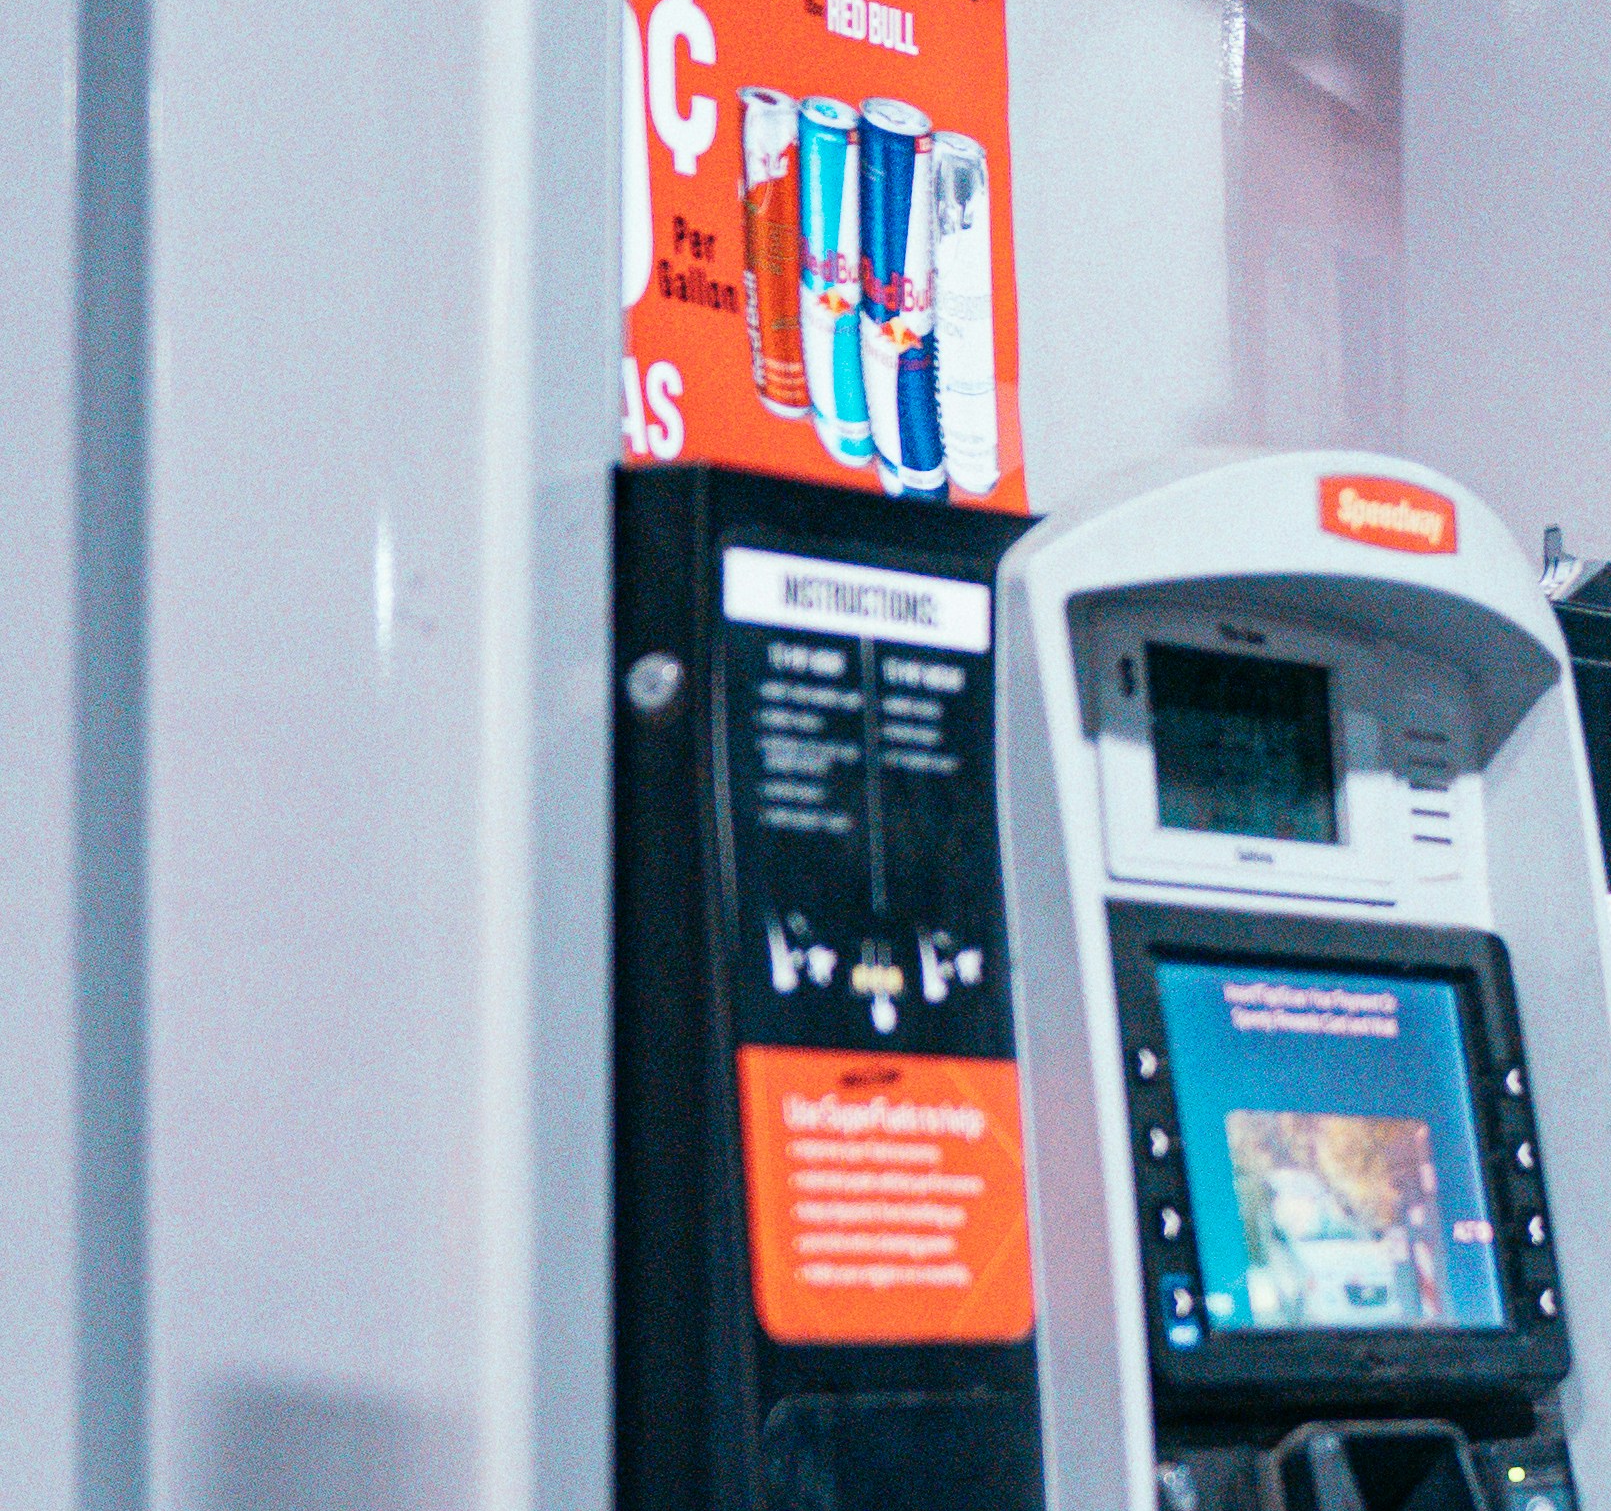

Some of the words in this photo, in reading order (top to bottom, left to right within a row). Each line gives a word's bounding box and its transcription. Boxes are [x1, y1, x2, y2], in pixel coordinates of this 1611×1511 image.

[867, 0, 920, 56] BULL
[671, 215, 715, 263] Per
[657, 258, 740, 313] Gallon
[1337, 487, 1445, 547] Speedway
